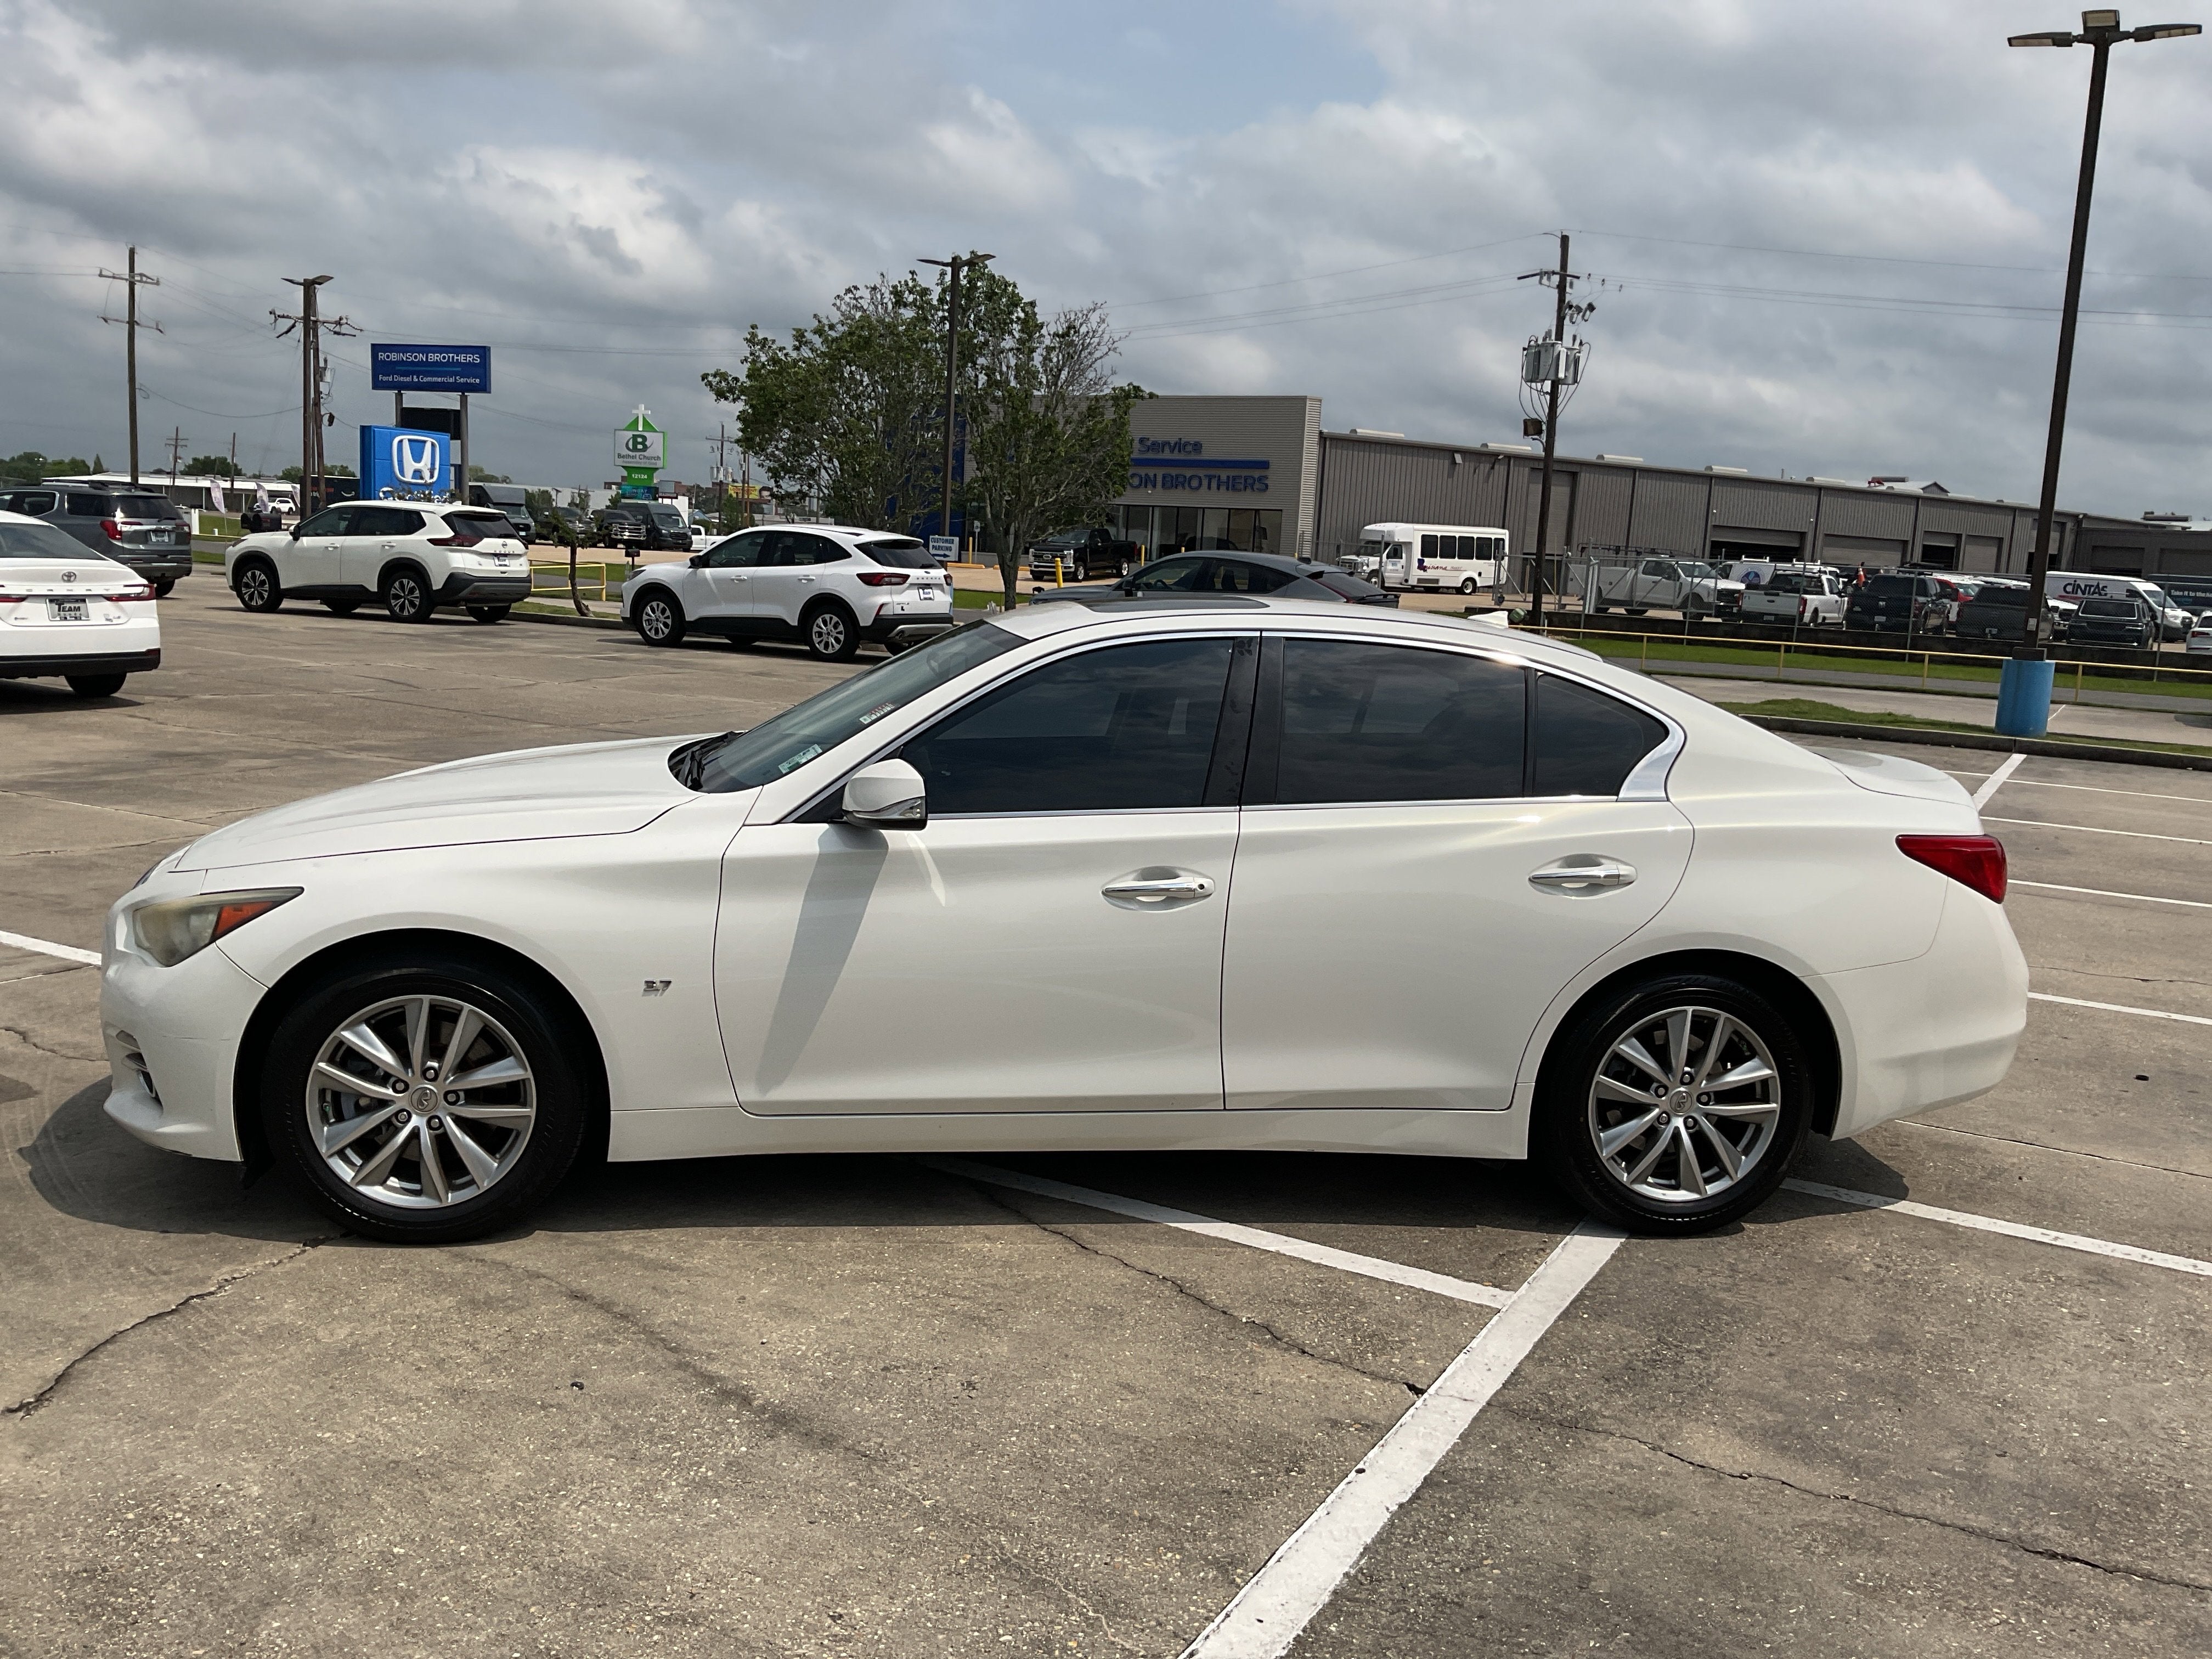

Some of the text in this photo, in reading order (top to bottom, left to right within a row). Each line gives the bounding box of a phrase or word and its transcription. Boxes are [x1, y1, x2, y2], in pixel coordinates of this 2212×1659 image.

[378, 352, 480, 363] ROBINSON BROTHERS
[1138, 437, 1203, 454] Service
[1161, 473, 1269, 493] BROTHERS
[2063, 579, 2108, 596] CINTAS
[55, 602, 81, 612] TEAM
